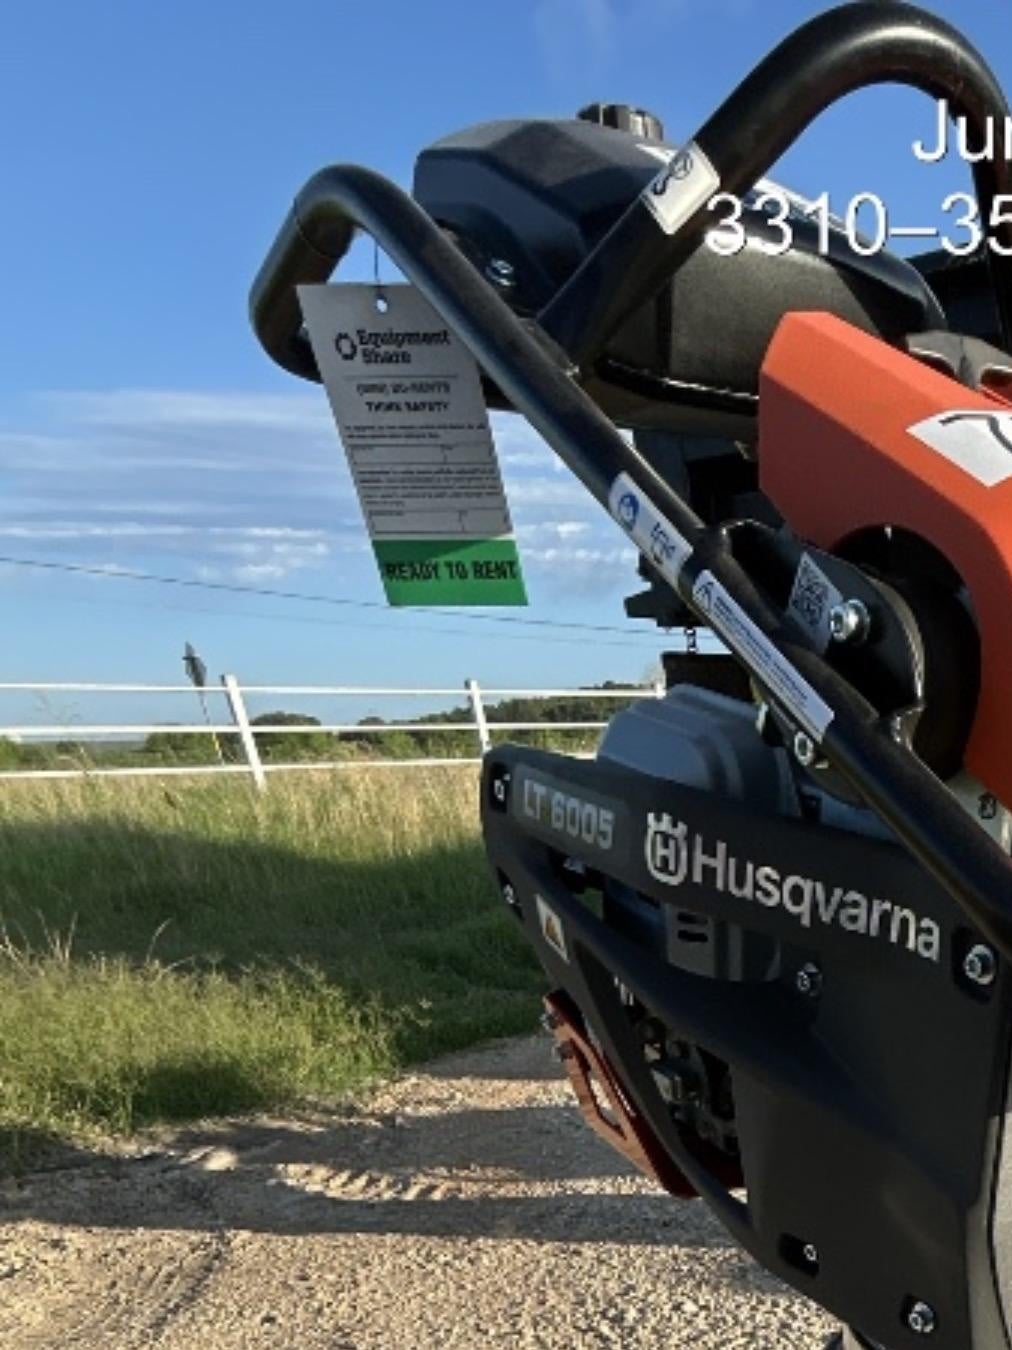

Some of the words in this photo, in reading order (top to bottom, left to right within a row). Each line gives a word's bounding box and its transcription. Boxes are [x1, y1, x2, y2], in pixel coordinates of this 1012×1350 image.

[356, 327, 450, 348] Equipment
[383, 560, 438, 580] READY
[444, 561, 469, 579] TO
[471, 560, 519, 580] RENT
[523, 778, 545, 820] LT
[551, 793, 616, 850] 6005
[692, 833, 940, 961] Husqvarna
